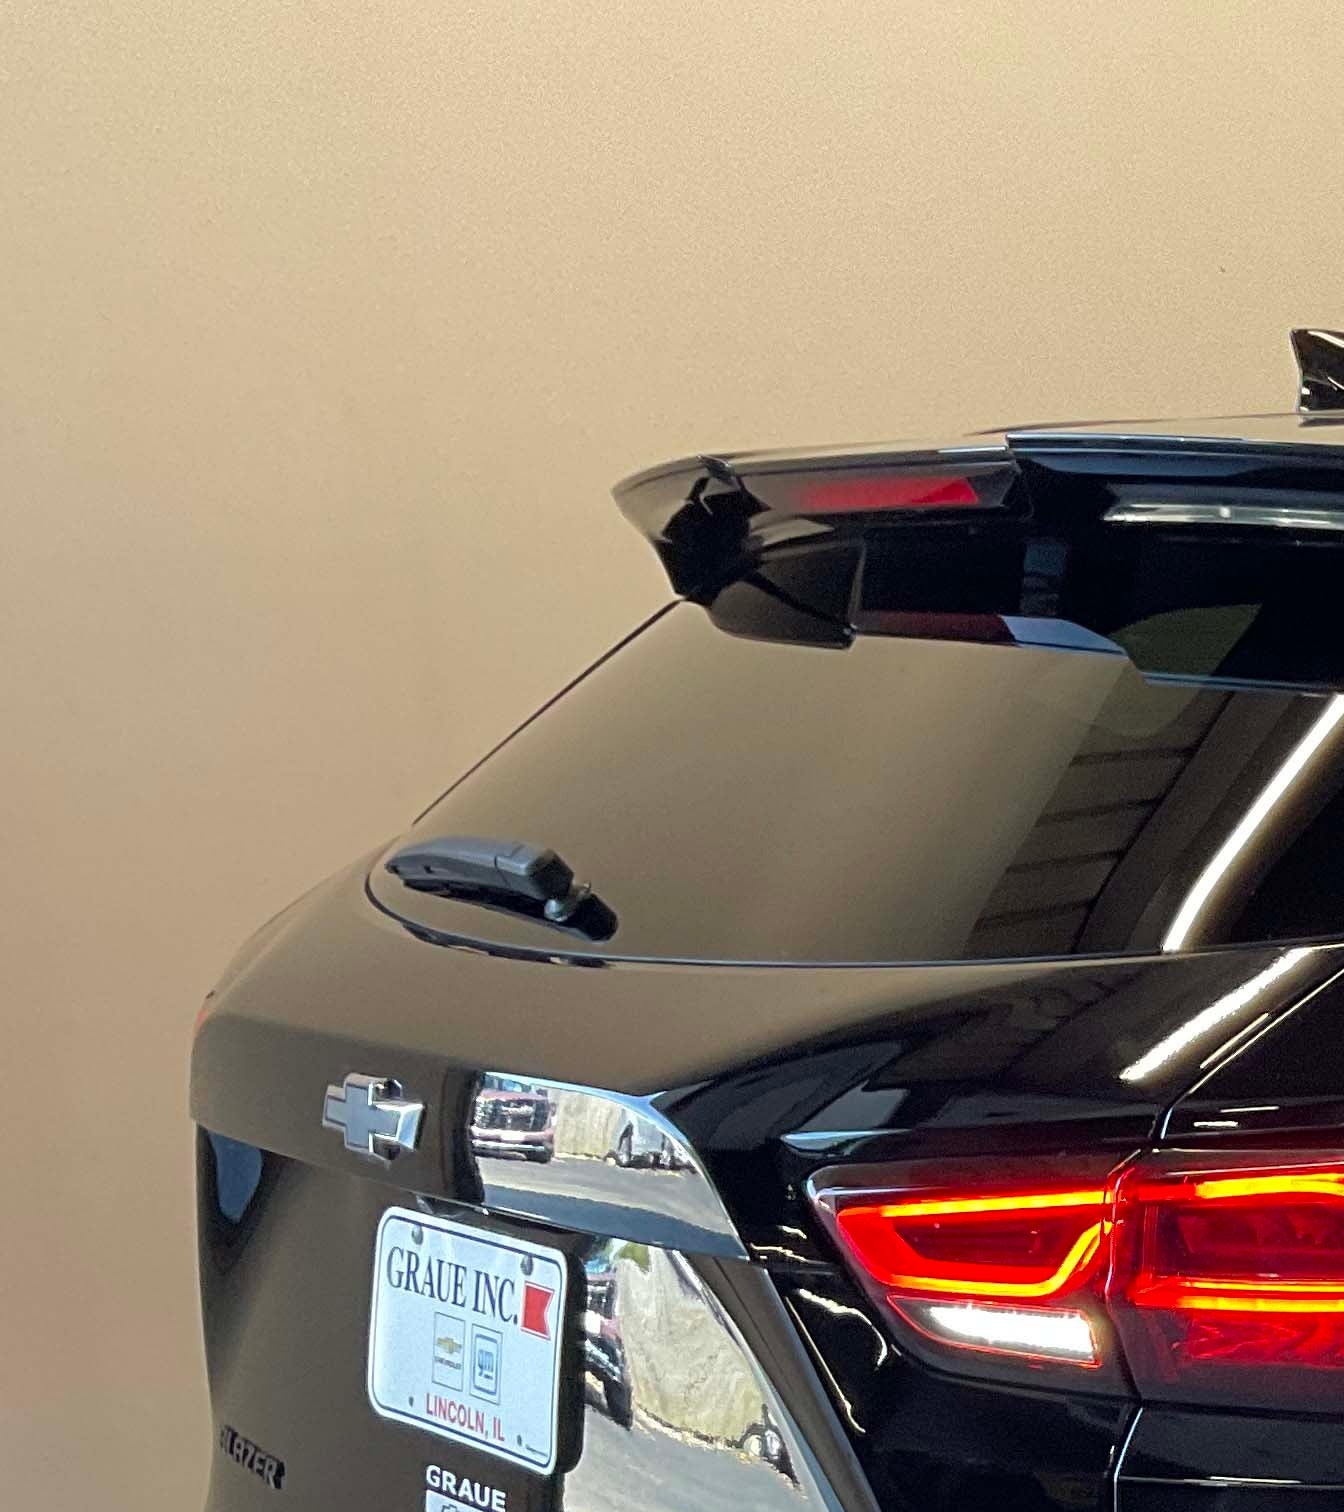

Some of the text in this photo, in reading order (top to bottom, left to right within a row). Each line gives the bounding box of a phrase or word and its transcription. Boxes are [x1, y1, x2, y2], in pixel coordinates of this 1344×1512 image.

[387, 1246, 518, 1326] GRAUE INC.
[425, 1393, 505, 1442] LINCOLN, IL
